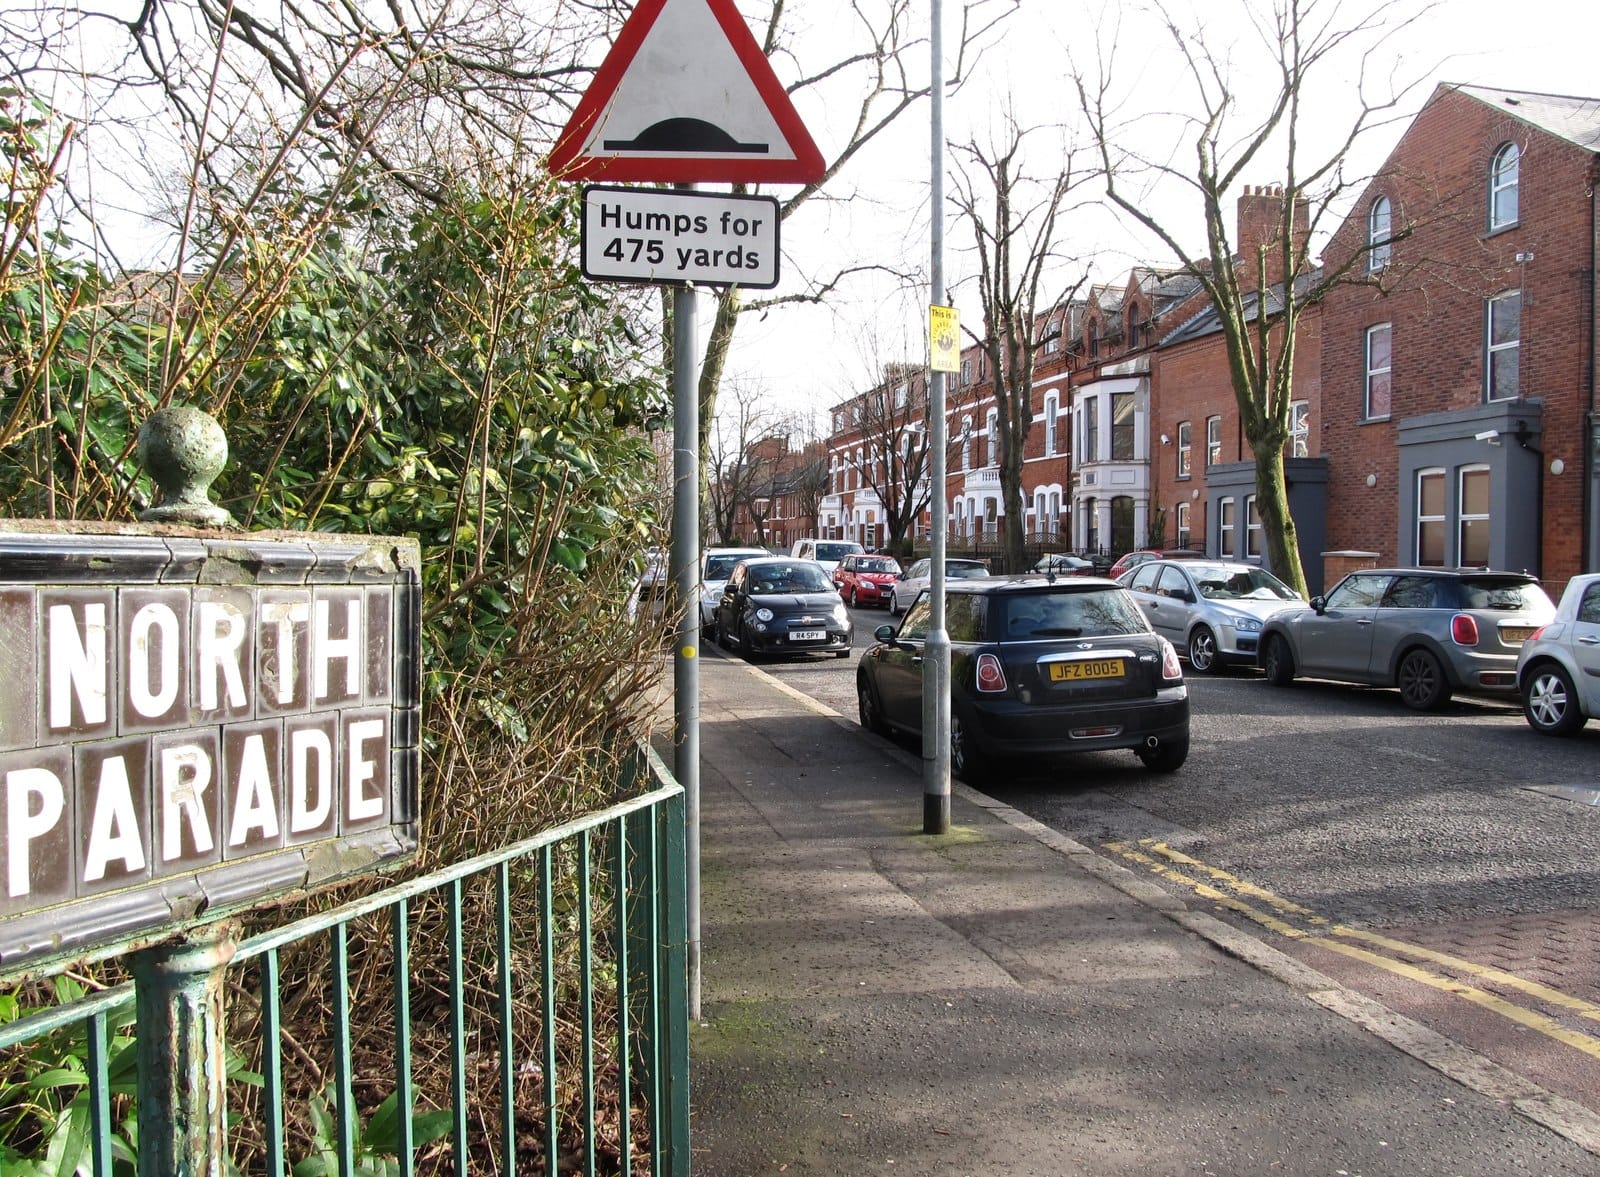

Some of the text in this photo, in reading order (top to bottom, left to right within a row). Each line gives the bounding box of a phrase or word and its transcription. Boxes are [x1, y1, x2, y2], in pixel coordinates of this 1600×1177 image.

[600, 204, 763, 237] Humps for
[603, 237, 760, 270] 475 yards
[932, 309, 945, 318] This
[946, 310, 952, 319] is
[49, 599, 361, 729] NORTH
[1056, 662, 1119, 677] JFZ 8005
[6, 719, 384, 898] PARADE
